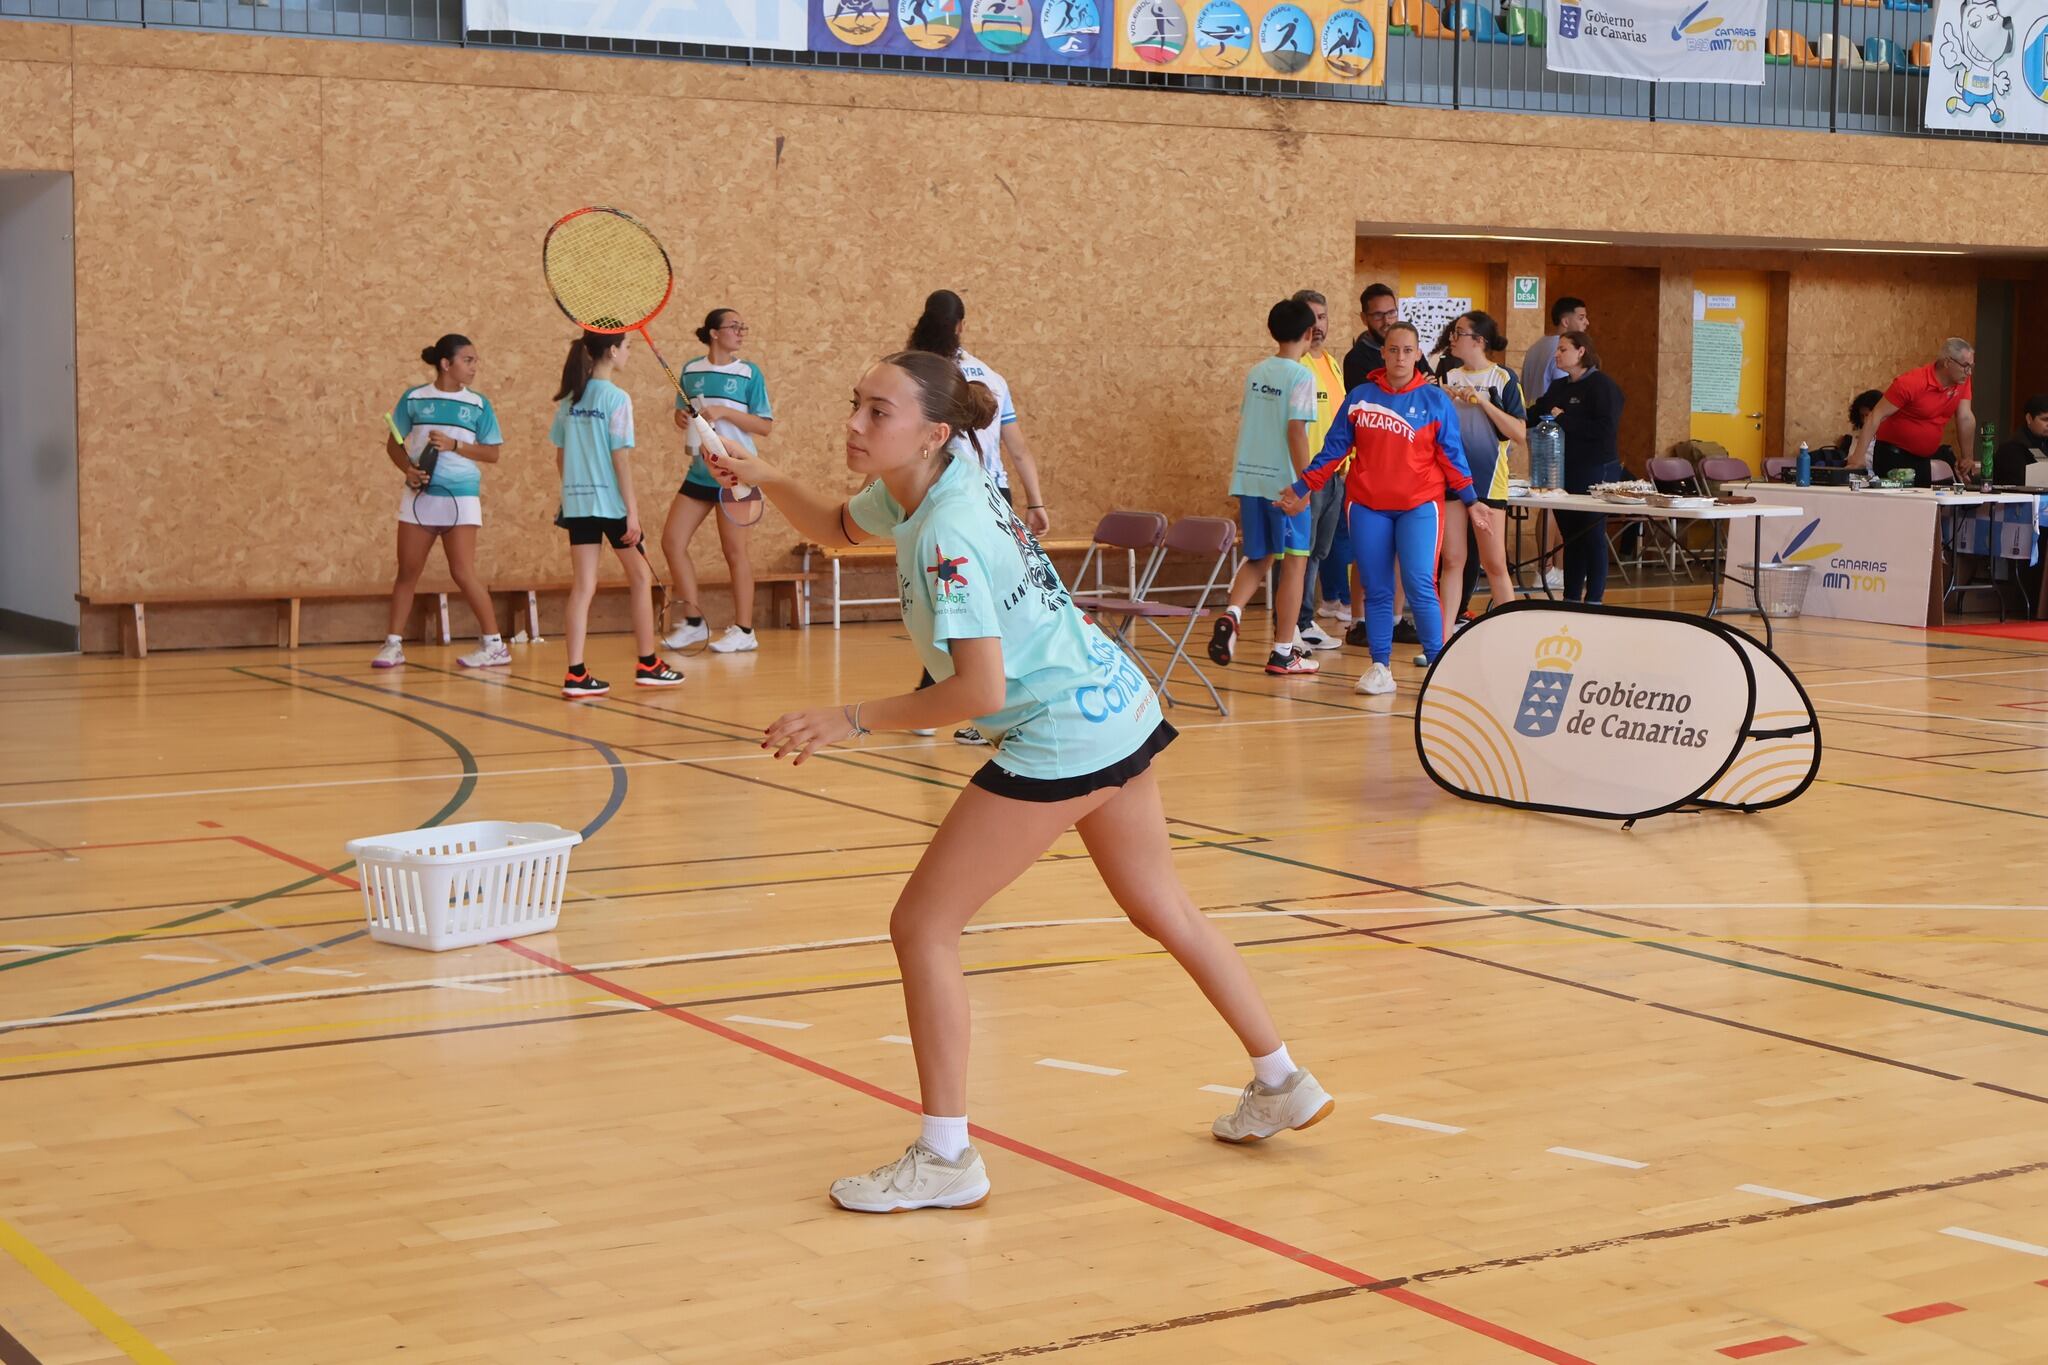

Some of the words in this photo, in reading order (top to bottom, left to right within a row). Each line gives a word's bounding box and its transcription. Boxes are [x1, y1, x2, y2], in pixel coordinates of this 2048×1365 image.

[1585, 9, 1634, 28] Gobierno
[1584, 23, 1598, 36] de
[1600, 25, 1647, 43] Canarias
[1517, 293, 1536, 301] DESA
[1261, 385, 1282, 396] Chen
[1353, 412, 1416, 443] ANZAROTE
[1831, 558, 1888, 573] CANARIAS
[1822, 572, 1887, 593] MINTON
[1579, 680, 1692, 714] Gobierno
[1566, 709, 1596, 735] de
[1601, 714, 1709, 748] Canarias
